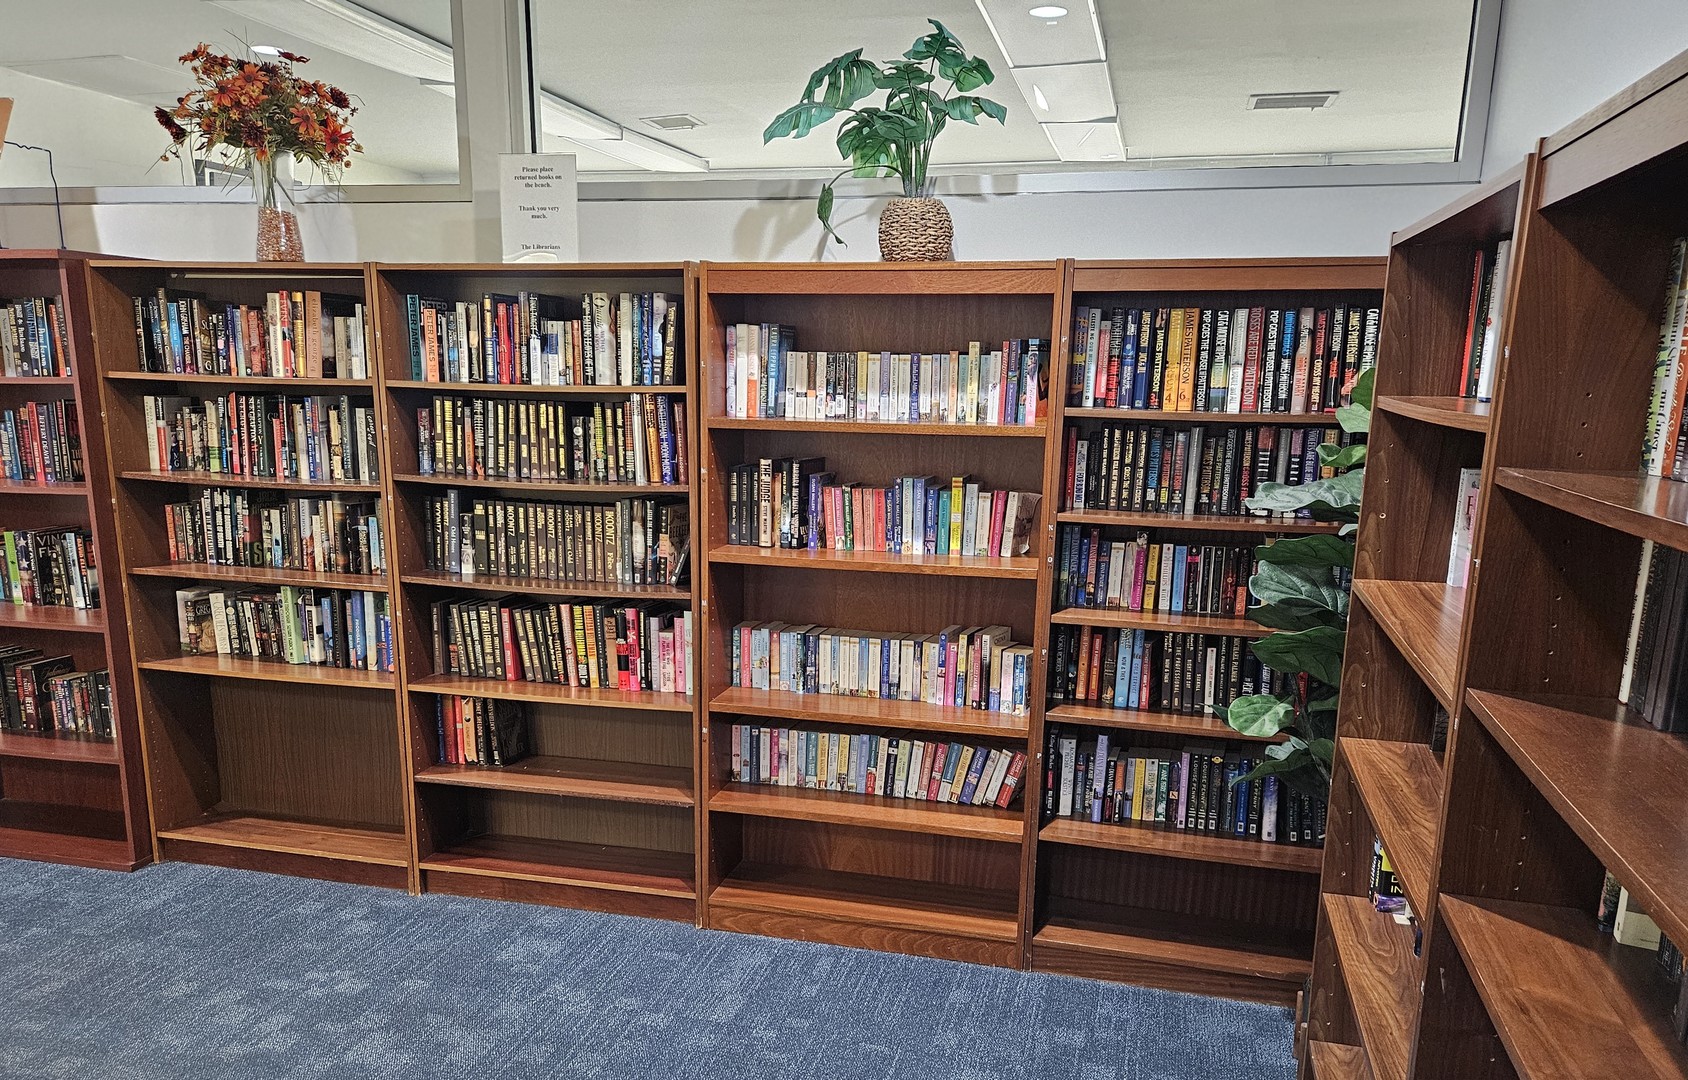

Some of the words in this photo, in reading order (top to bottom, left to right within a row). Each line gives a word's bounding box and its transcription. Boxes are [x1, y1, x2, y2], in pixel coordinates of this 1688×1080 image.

[179, 301, 187, 312] JOHN
[409, 297, 418, 324] PETER
[1202, 310, 1211, 322] POP
[1217, 311, 1229, 320] CAT
[1269, 310, 1279, 322] POP
[1334, 308, 1344, 323] JAMES
[1367, 309, 1379, 320] CAT
[1141, 311, 1150, 324] JAMES
[1184, 311, 1194, 336] JAMES
[1250, 309, 1261, 330] ROSES
[1348, 311, 1360, 330] JAMES
[1140, 325, 1150, 347] PATTERSON
[1155, 330, 1165, 351] JAMES
[1201, 323, 1210, 338] GOES
[1249, 332, 1259, 344] ARE
[1268, 324, 1278, 338] GOES
[1332, 324, 1342, 351] PATTERSON
[310, 339, 318, 364] george
[410, 327, 420, 356] JAMES
[1200, 339, 1209, 349] THE
[1267, 340, 1277, 350] THE
[1182, 338, 1192, 384] PATTERSON
[1199, 351, 1208, 371] WEASEL
[1247, 346, 1258, 359] RED
[1266, 352, 1276, 372] WEASEL
[1152, 352, 1163, 392] PATTERSON
[1196, 375, 1206, 406] PATTERSON
[1243, 366, 1256, 404] PATTERSON
[1263, 377, 1274, 408] PATTERSON
[1656, 390, 1668, 411] THE
[1306, 430, 1317, 450] VIOLETS
[1651, 414, 1667, 452] GHOST
[660, 442, 669, 458] MOON
[1150, 439, 1160, 457] JAMES
[1305, 451, 1315, 460] ARE
[626, 451, 634, 471] MOTIVE
[662, 460, 670, 475] MUSIC
[761, 464, 770, 477] THE
[1148, 459, 1159, 487] PATTERSON
[1174, 461, 1183, 489] PATTERSON
[761, 479, 770, 503] JUDGE
[605, 515, 615, 545] KOONTZ
[1056, 652, 1064, 672] ROBERTS
